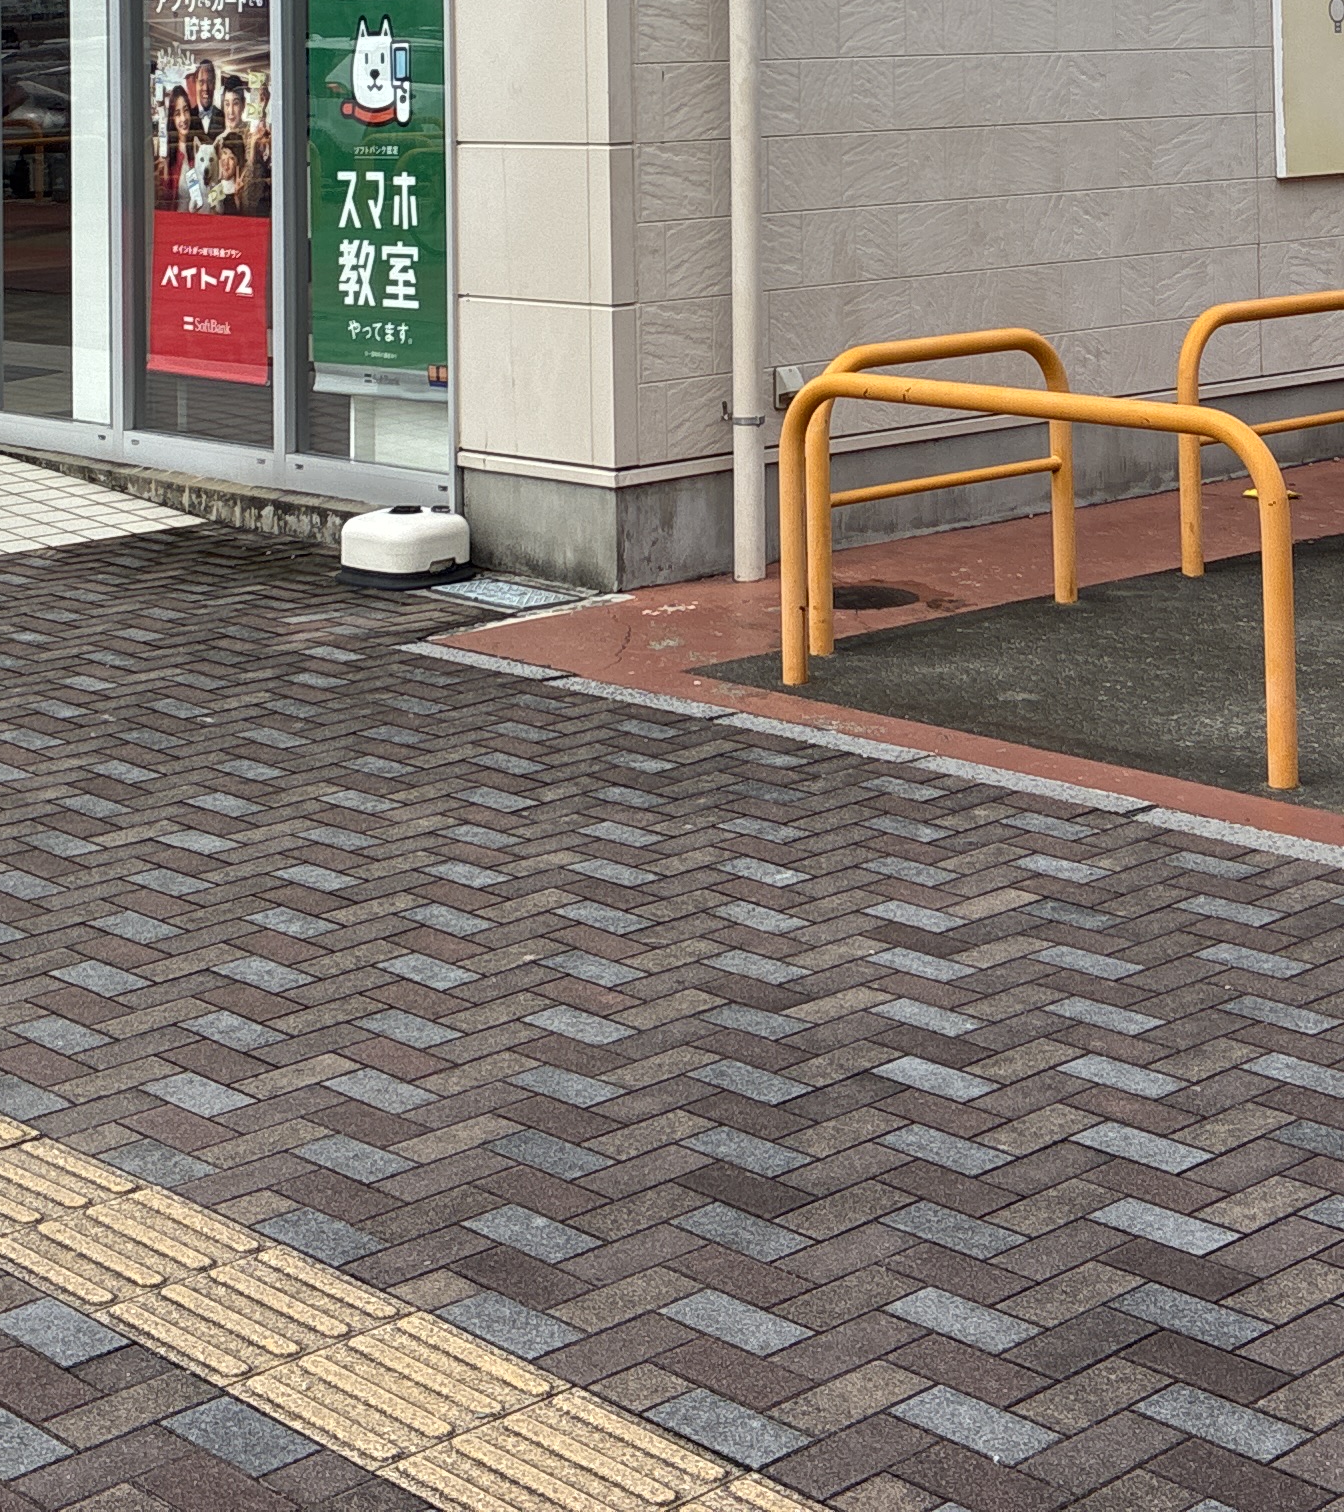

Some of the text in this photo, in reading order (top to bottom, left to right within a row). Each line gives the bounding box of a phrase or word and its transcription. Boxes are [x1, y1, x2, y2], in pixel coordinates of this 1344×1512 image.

[183, 16, 230, 41] 貯まる!
[336, 170, 419, 230] スマホ
[160, 264, 255, 296] ペイトク2
[338, 238, 421, 310] 教室
[194, 317, 232, 335] SoftBank
[347, 319, 414, 346] やってます。
